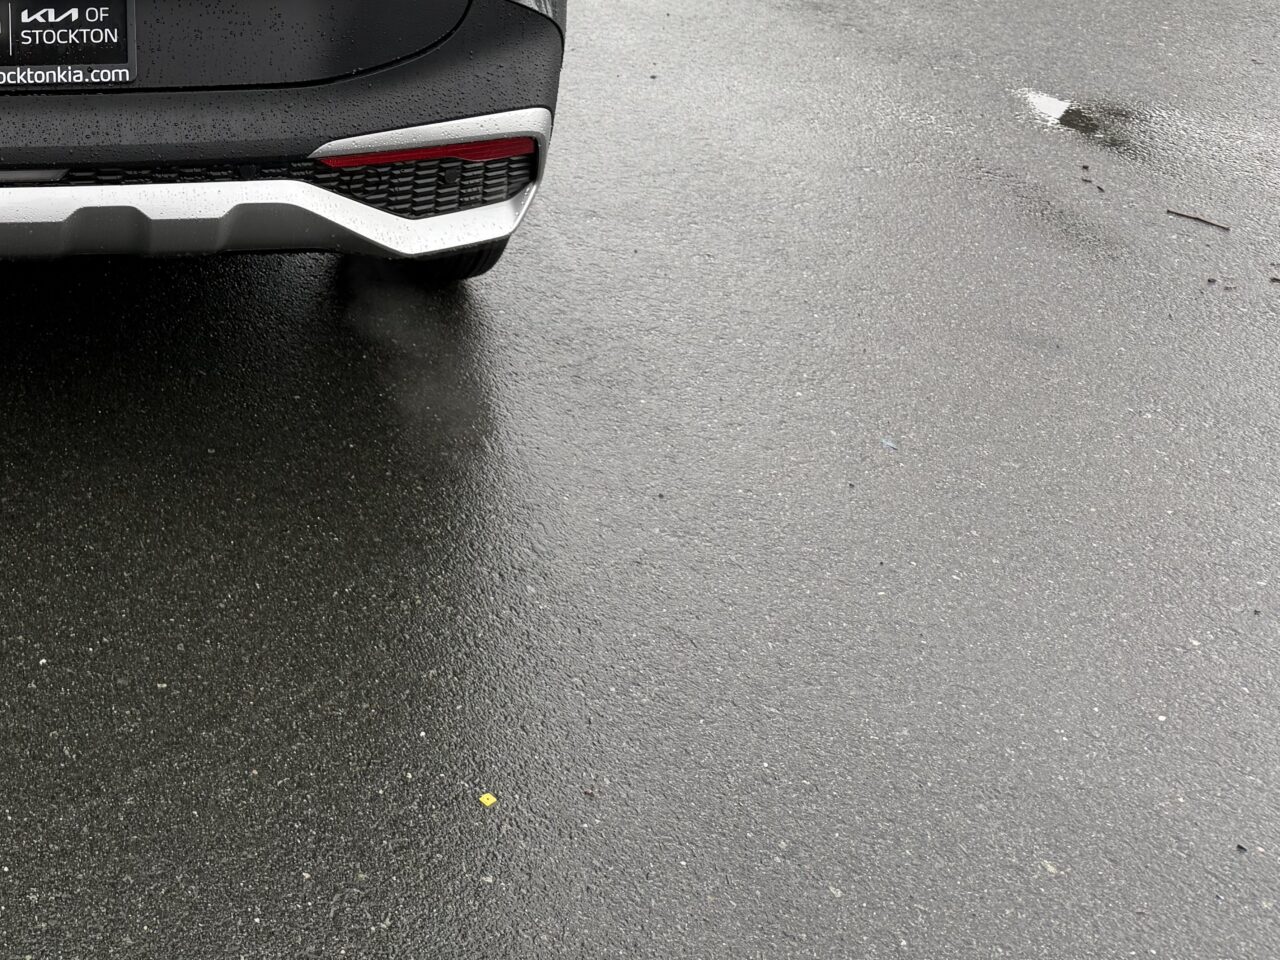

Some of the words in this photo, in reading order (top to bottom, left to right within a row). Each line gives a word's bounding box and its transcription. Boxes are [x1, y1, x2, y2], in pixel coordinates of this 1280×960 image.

[21, 8, 79, 23] KIA
[85, 7, 109, 22] OF
[21, 28, 118, 45] STOCKTON
